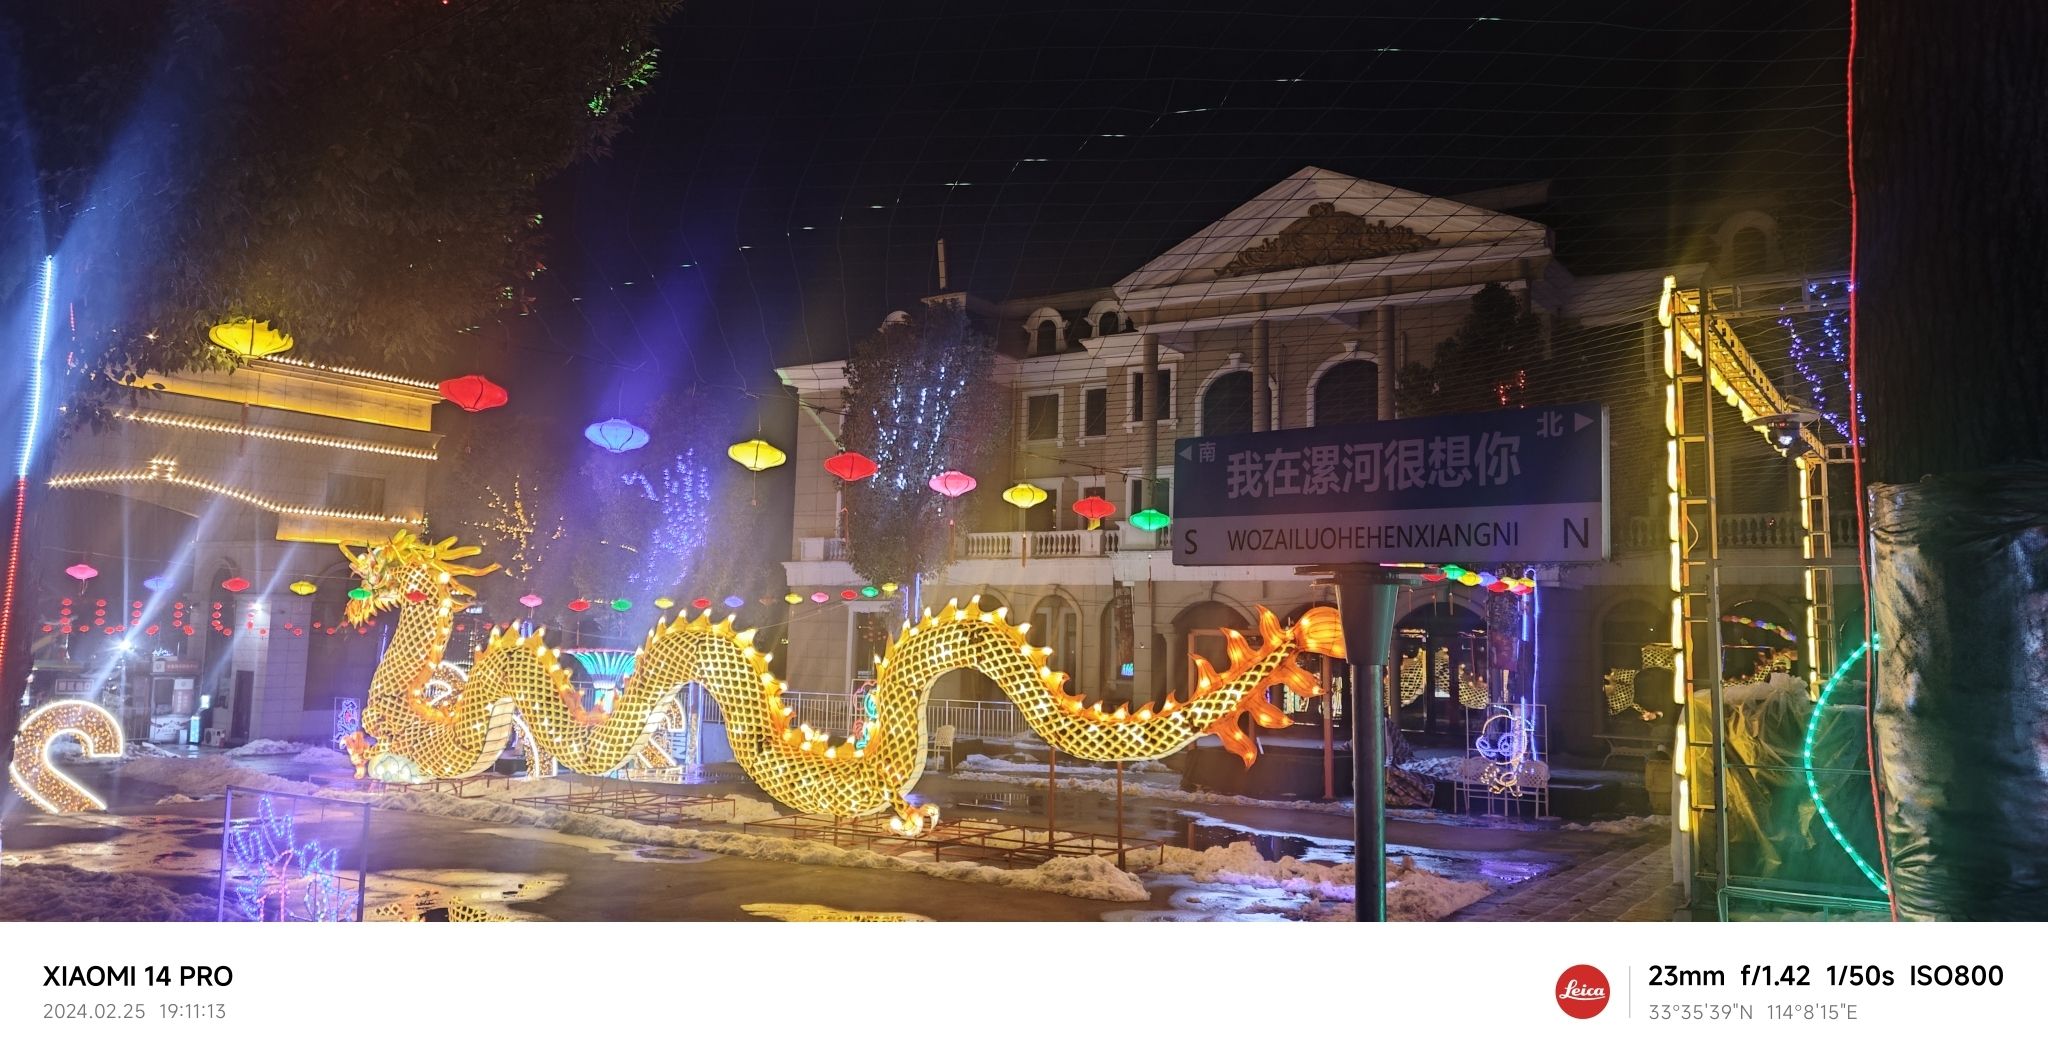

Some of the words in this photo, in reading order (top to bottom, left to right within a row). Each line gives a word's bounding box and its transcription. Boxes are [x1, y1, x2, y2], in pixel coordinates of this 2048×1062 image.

[1537, 411, 1564, 438] 北
[1199, 442, 1216, 463] 南
[1226, 431, 1521, 499] 我在漯河很想你
[1184, 529, 1198, 555] S
[1227, 521, 1519, 551] WOZAILUOHEHENXIANGNI
[1563, 517, 1590, 549] N
